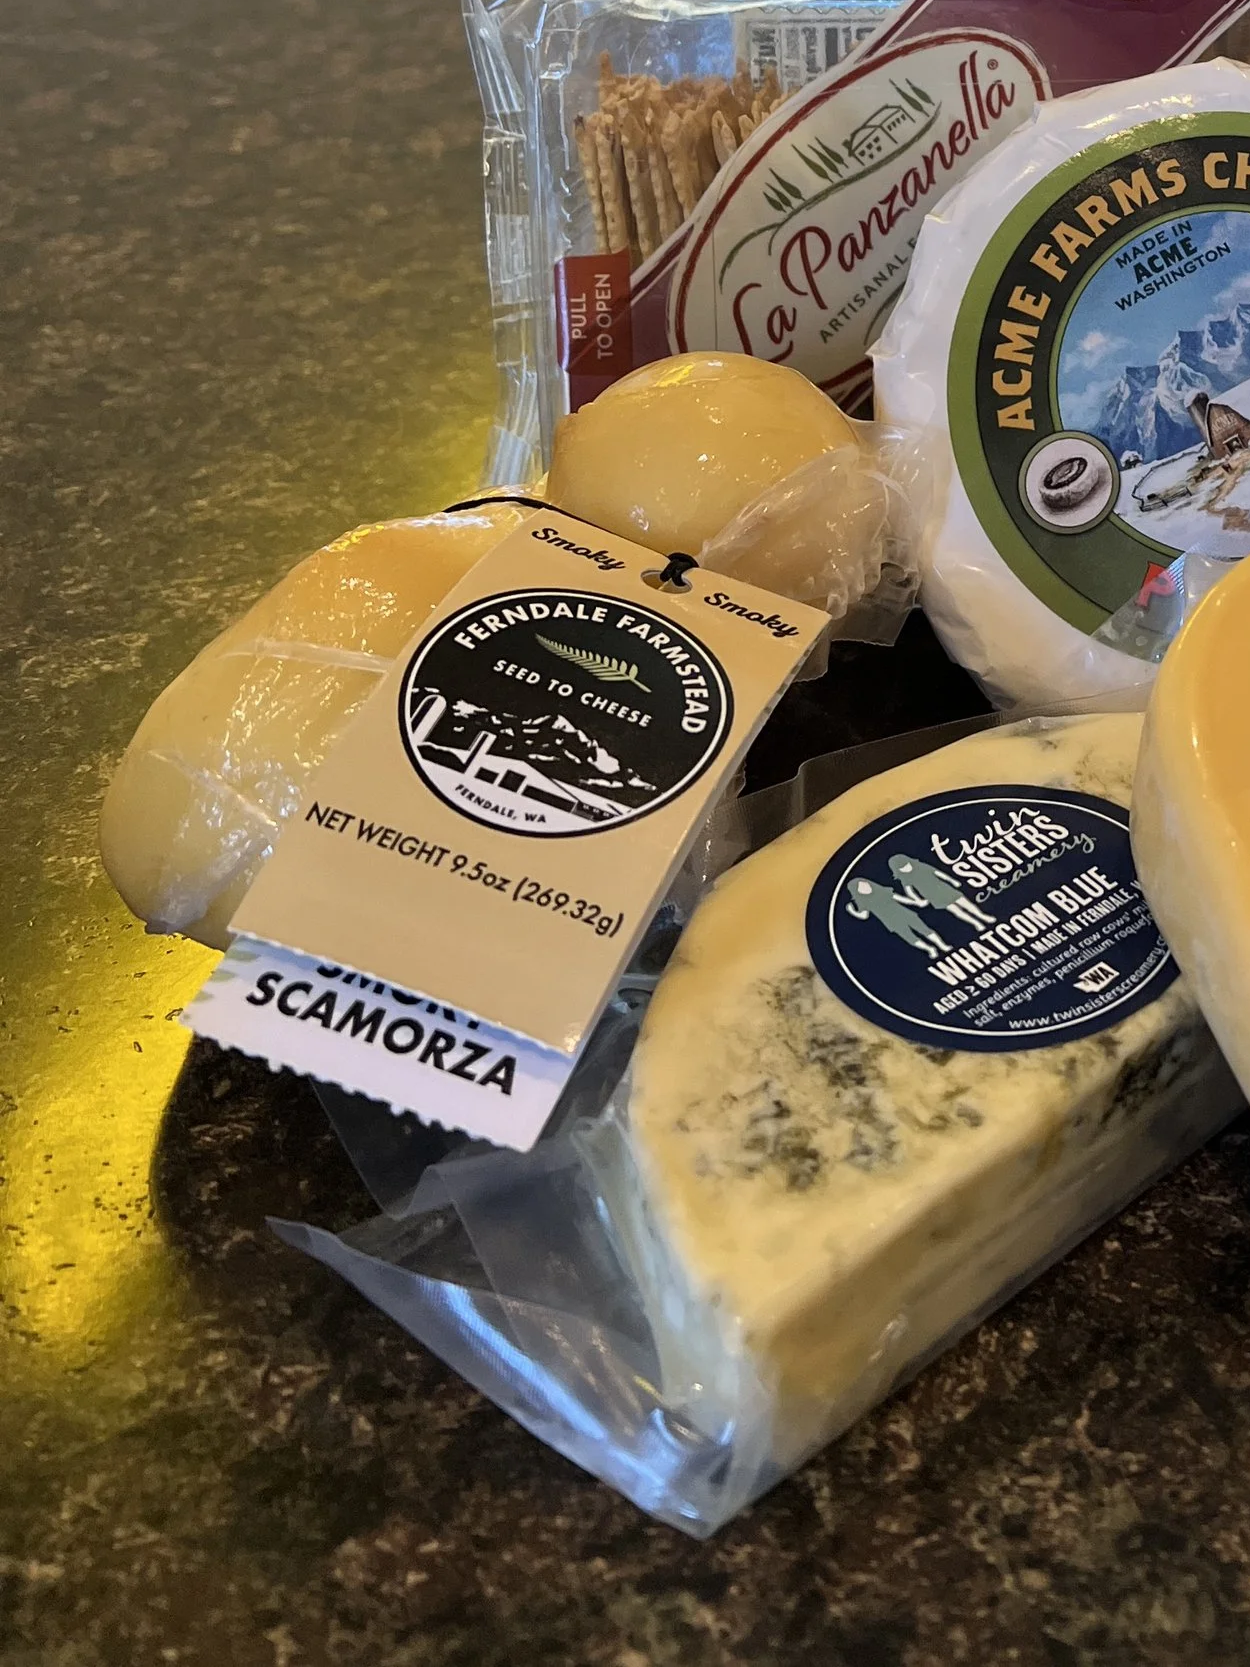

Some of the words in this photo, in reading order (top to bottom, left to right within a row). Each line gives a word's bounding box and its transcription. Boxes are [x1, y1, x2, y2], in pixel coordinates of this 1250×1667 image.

[1114, 230, 1170, 269] MADE
[1170, 220, 1194, 237] IN
[1114, 242, 1232, 312] WASHINGTON
[1132, 236, 1198, 285] ACME
[569, 292, 588, 340] PULL
[593, 273, 613, 329] OPEN
[733, 282, 797, 364] La
[819, 253, 909, 344] ARTISANAL
[991, 283, 1053, 432] ACME
[1029, 157, 1188, 284] FARMS
[596, 333, 614, 360] TO
[531, 527, 626, 571] Smoky
[703, 592, 800, 638] Smoky
[453, 601, 609, 651] FERNDALE
[614, 614, 711, 734] FARMSTEAD
[492, 659, 541, 685] SEED
[547, 678, 573, 697] TO
[580, 692, 653, 728] CHEESE
[454, 784, 518, 820] FERNDALE,
[524, 812, 547, 823] WA
[930, 806, 1041, 866] twin
[305, 801, 356, 834] NET
[356, 818, 451, 868] WEIGHT
[449, 853, 512, 893] 9.5oz
[511, 876, 625, 938] (269.32g)
[951, 814, 1070, 889] SISTERS
[974, 832, 1098, 904] creamery
[927, 900, 1061, 987] WHATCOM
[1047, 865, 1119, 915] BLUE
[1032, 944, 1080, 978] cultured
[1078, 931, 1101, 949] raw
[932, 988, 970, 1015] AGED
[973, 972, 997, 990] 60
[996, 953, 1028, 979] DAYS
[1029, 932, 1068, 956] MADE
[1061, 919, 1083, 936] IN
[245, 970, 519, 1097] SCAMORZA
